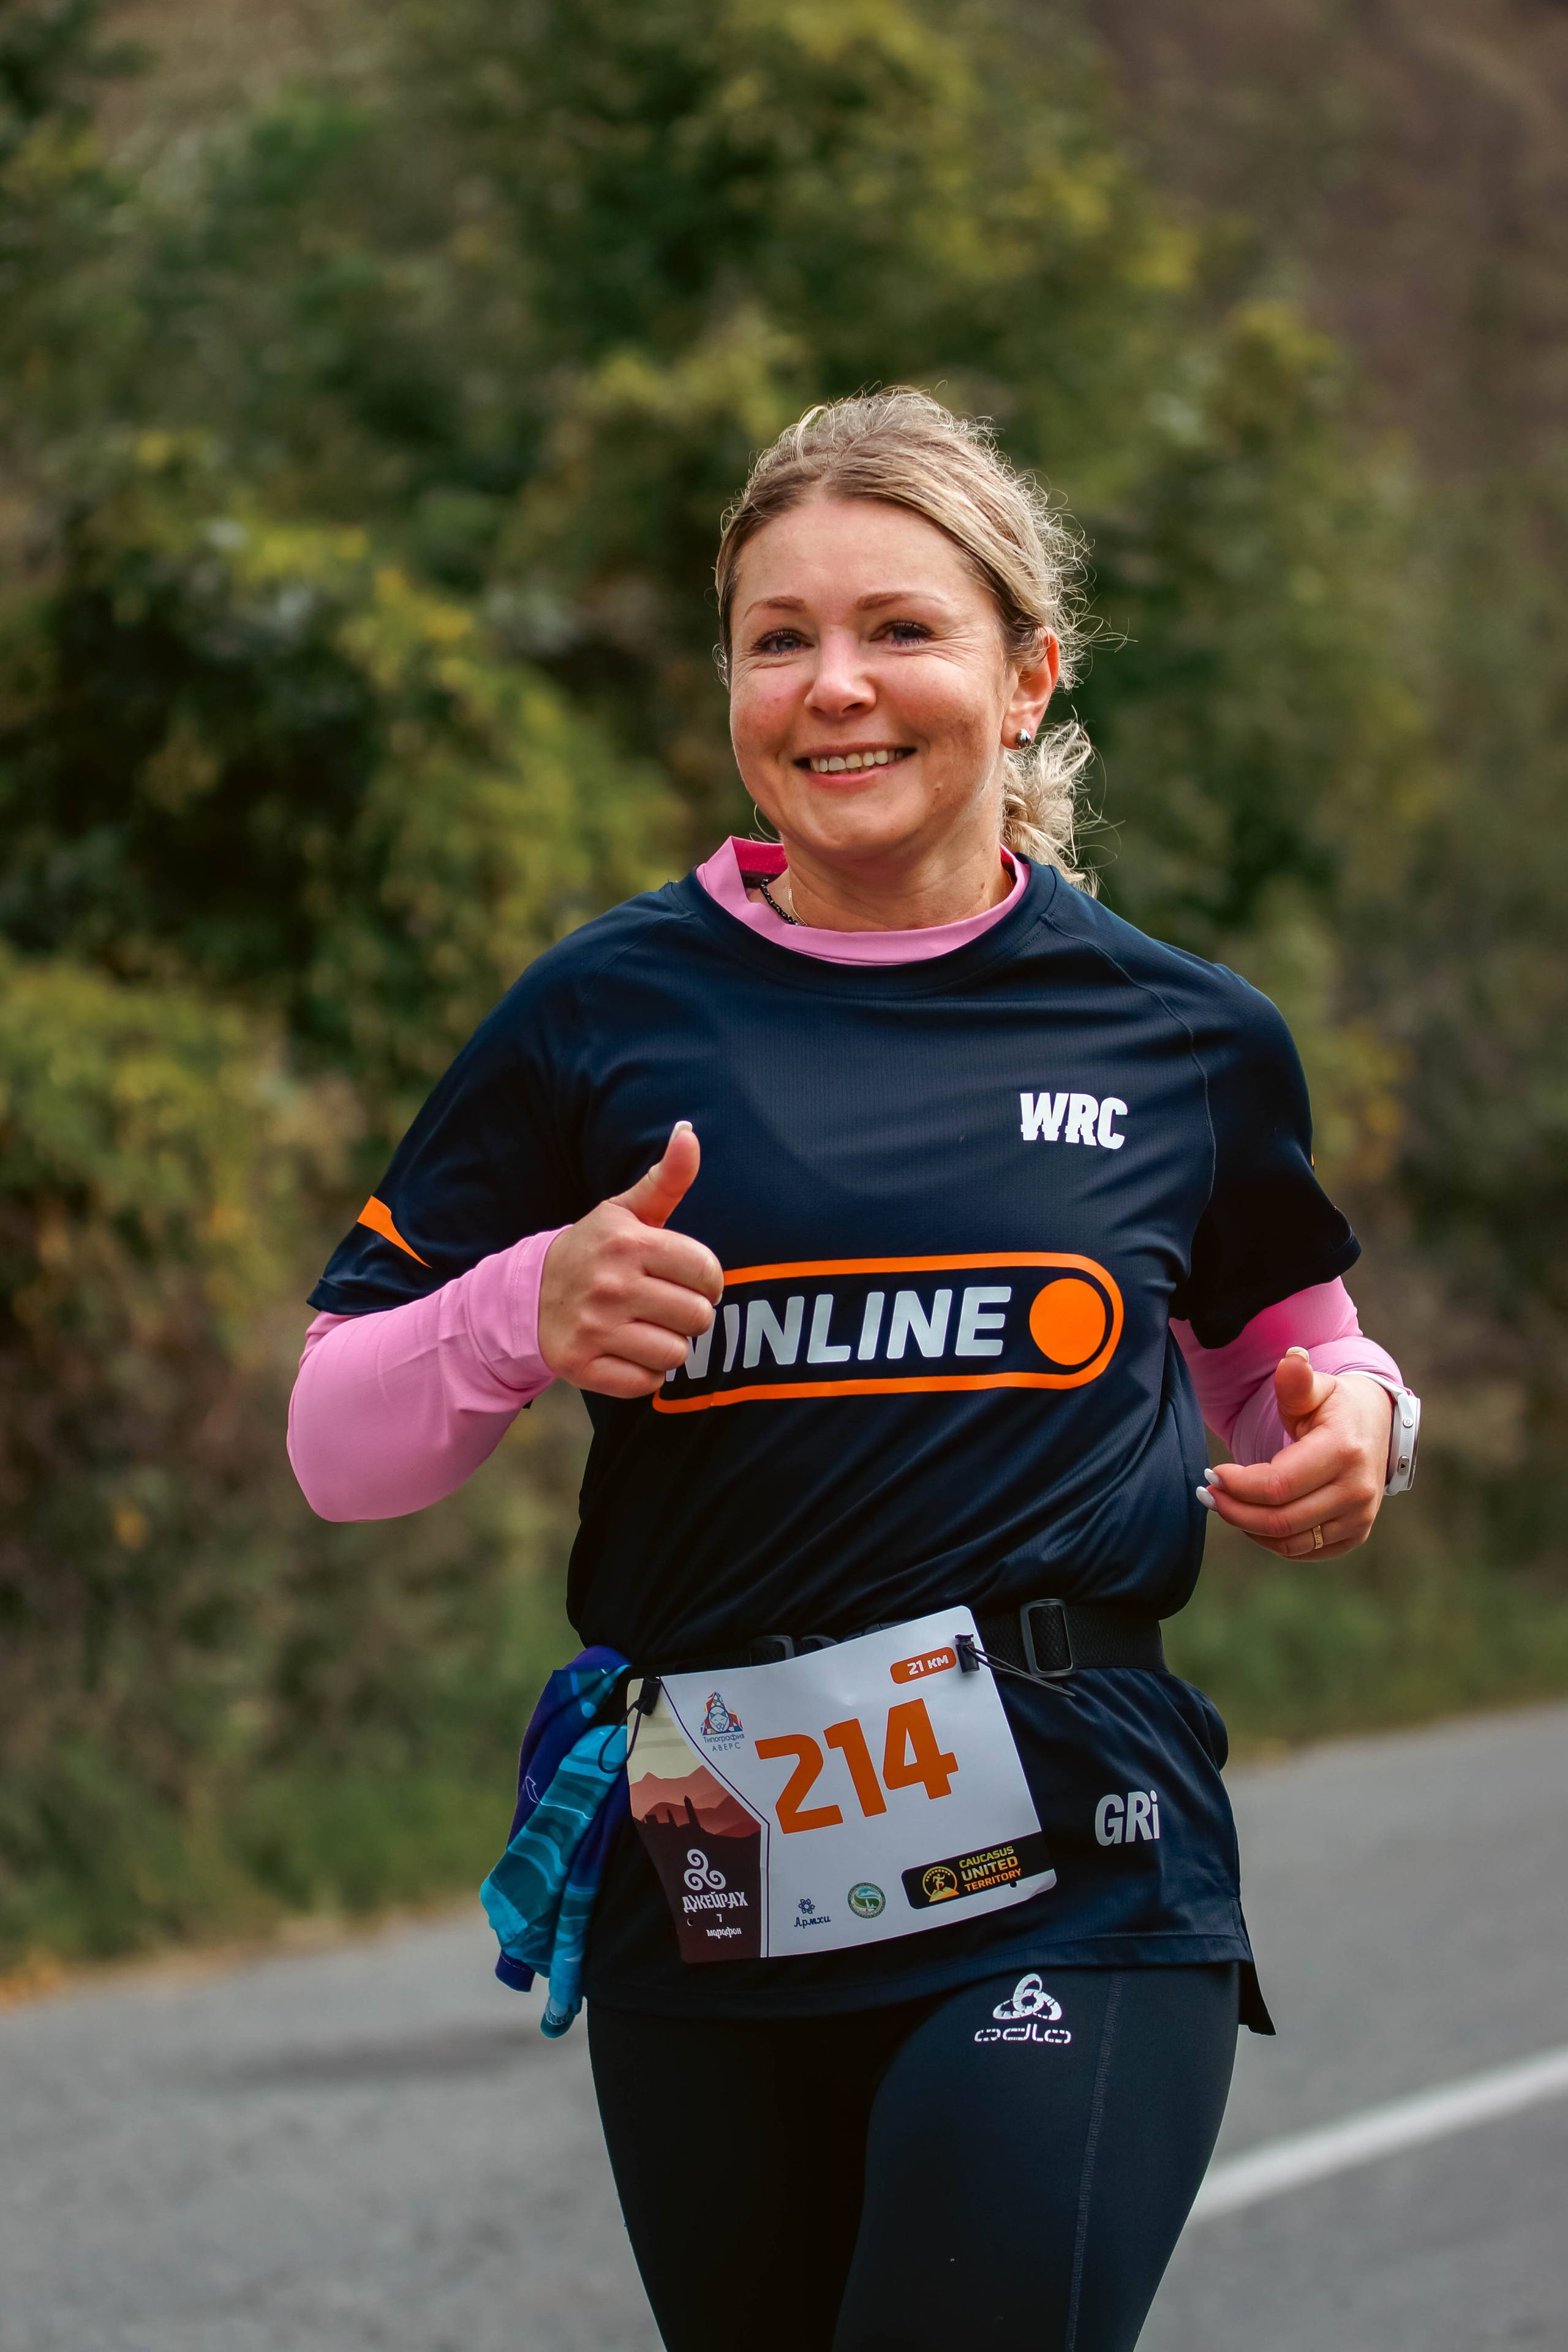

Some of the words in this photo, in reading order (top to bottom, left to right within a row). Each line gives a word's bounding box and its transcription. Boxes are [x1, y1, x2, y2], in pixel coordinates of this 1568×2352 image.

[1020, 1093, 1128, 1149] WRC
[907, 1660, 924, 1675] 21
[703, 1733, 745, 1743] Типография
[712, 1742, 741, 1752] АВЕРС
[755, 1698, 959, 1834] 214
[959, 1845, 1014, 1868] CAUCASUS
[961, 1856, 1018, 1881] UNITED
[964, 1868, 1021, 1891] TERRITORY
[682, 1891, 748, 1913] ДЖЕЙРАХ
[706, 1926, 742, 1939] марафон
[794, 1915, 831, 1929] Армхи
